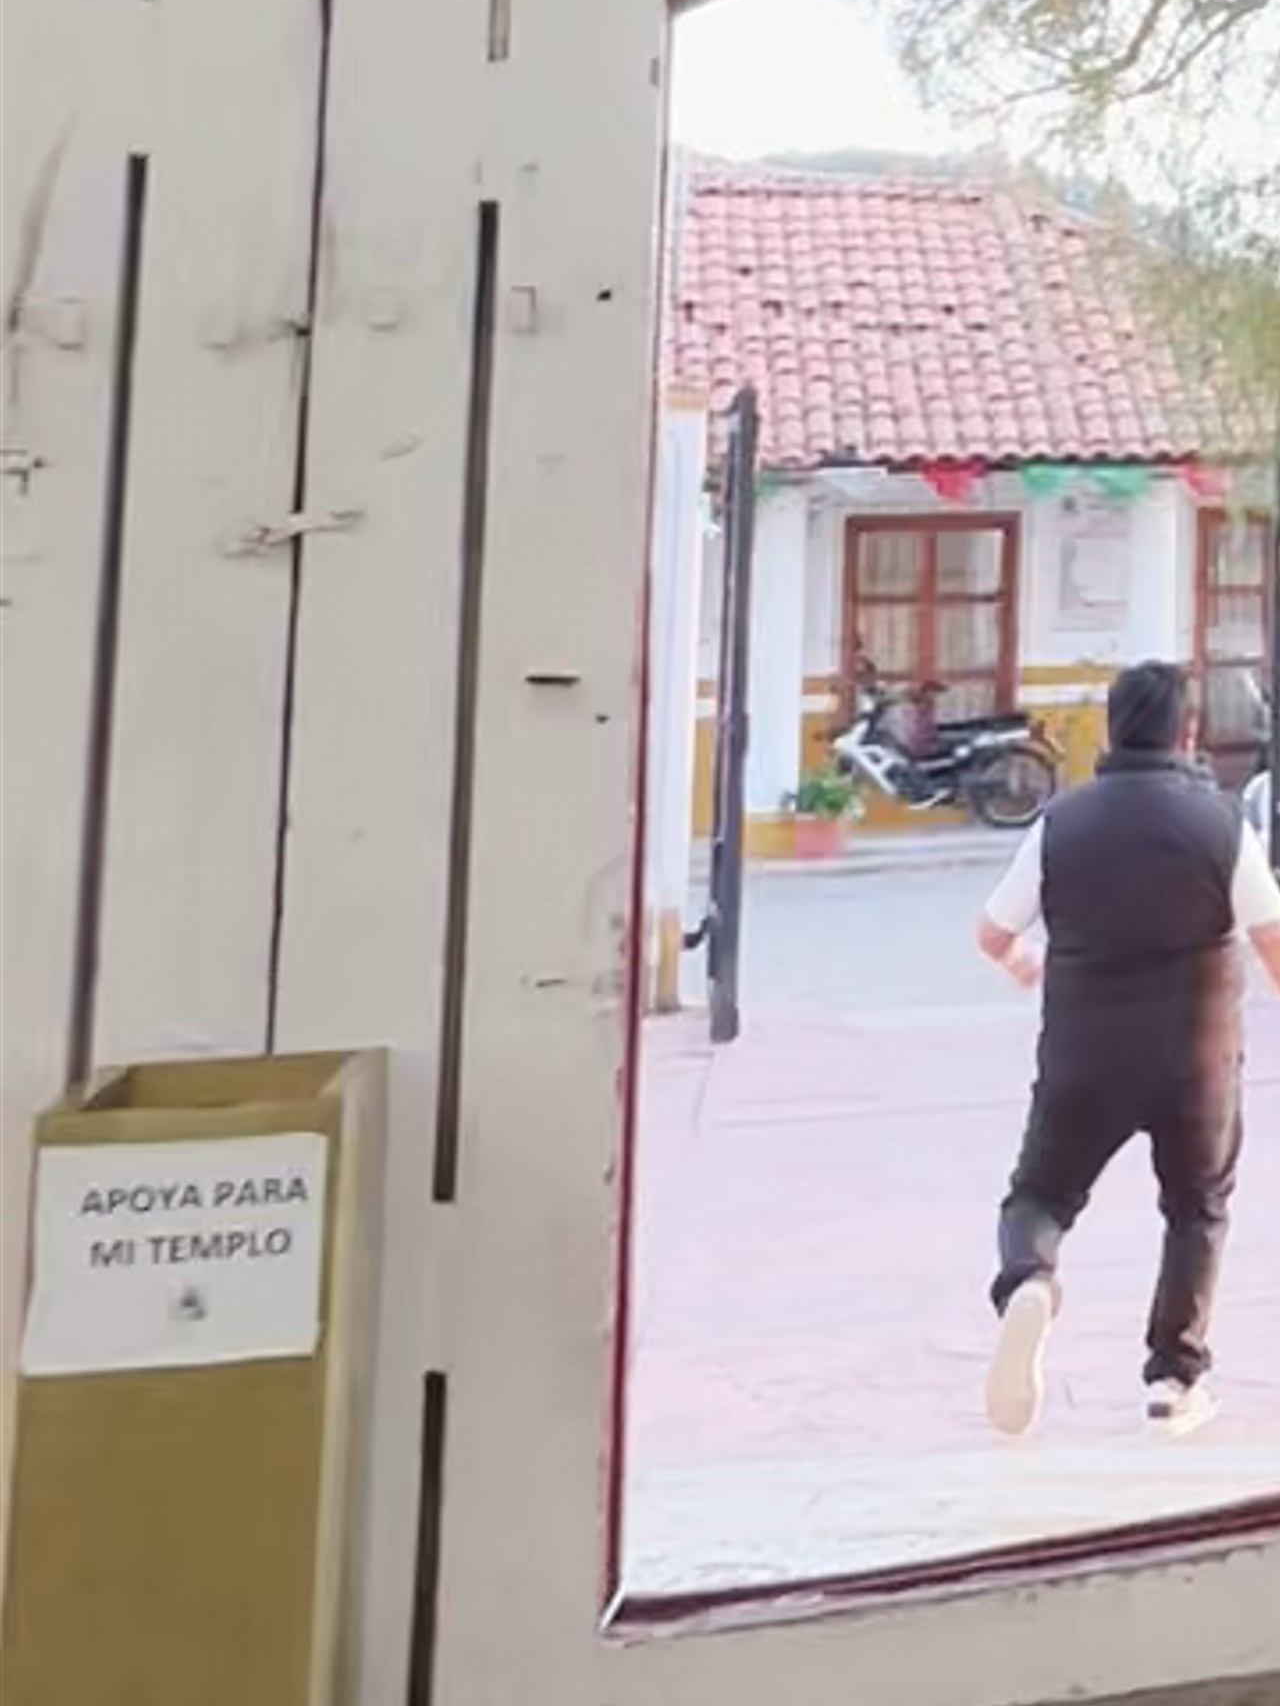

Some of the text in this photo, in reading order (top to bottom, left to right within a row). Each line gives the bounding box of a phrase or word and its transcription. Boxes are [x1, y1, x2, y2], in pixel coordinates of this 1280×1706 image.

[79, 1176, 310, 1215] APOYA PARA
[90, 1228, 293, 1268] MI TEMPLO
